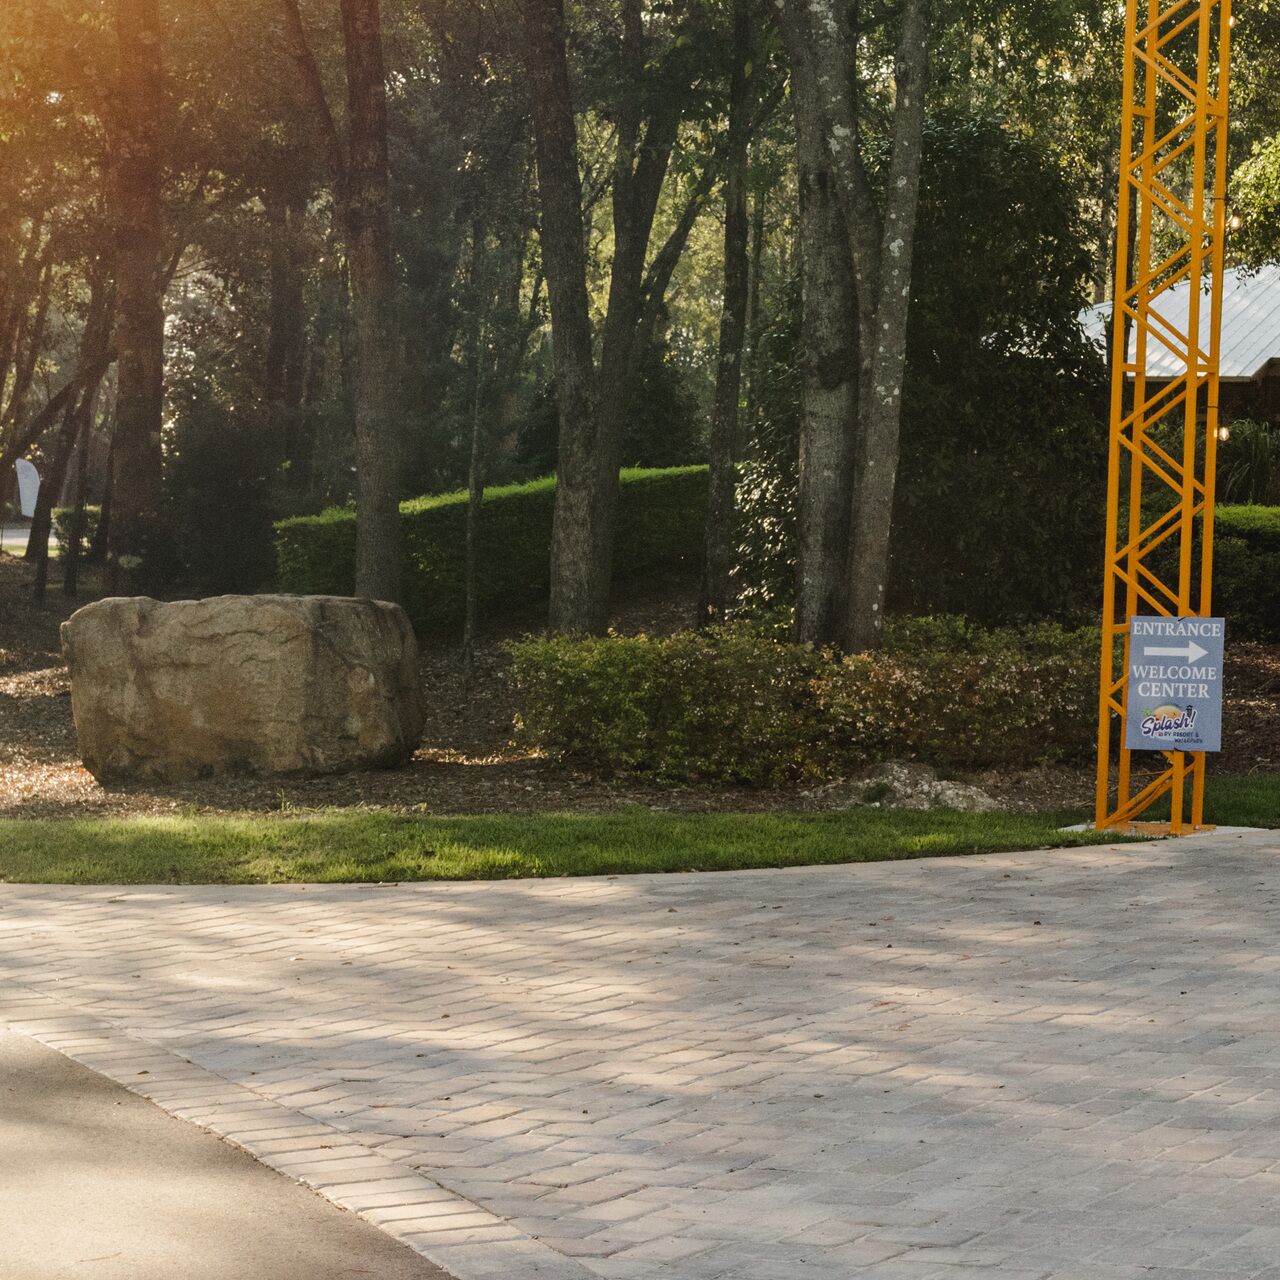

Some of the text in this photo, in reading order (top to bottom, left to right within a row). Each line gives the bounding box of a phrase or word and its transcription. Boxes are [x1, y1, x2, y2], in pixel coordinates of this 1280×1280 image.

[1132, 622, 1221, 637] ENTRANCE
[1132, 665, 1217, 680] WELCOME
[1137, 682, 1210, 698] CENTER
[1141, 710, 1197, 737] Splash!
